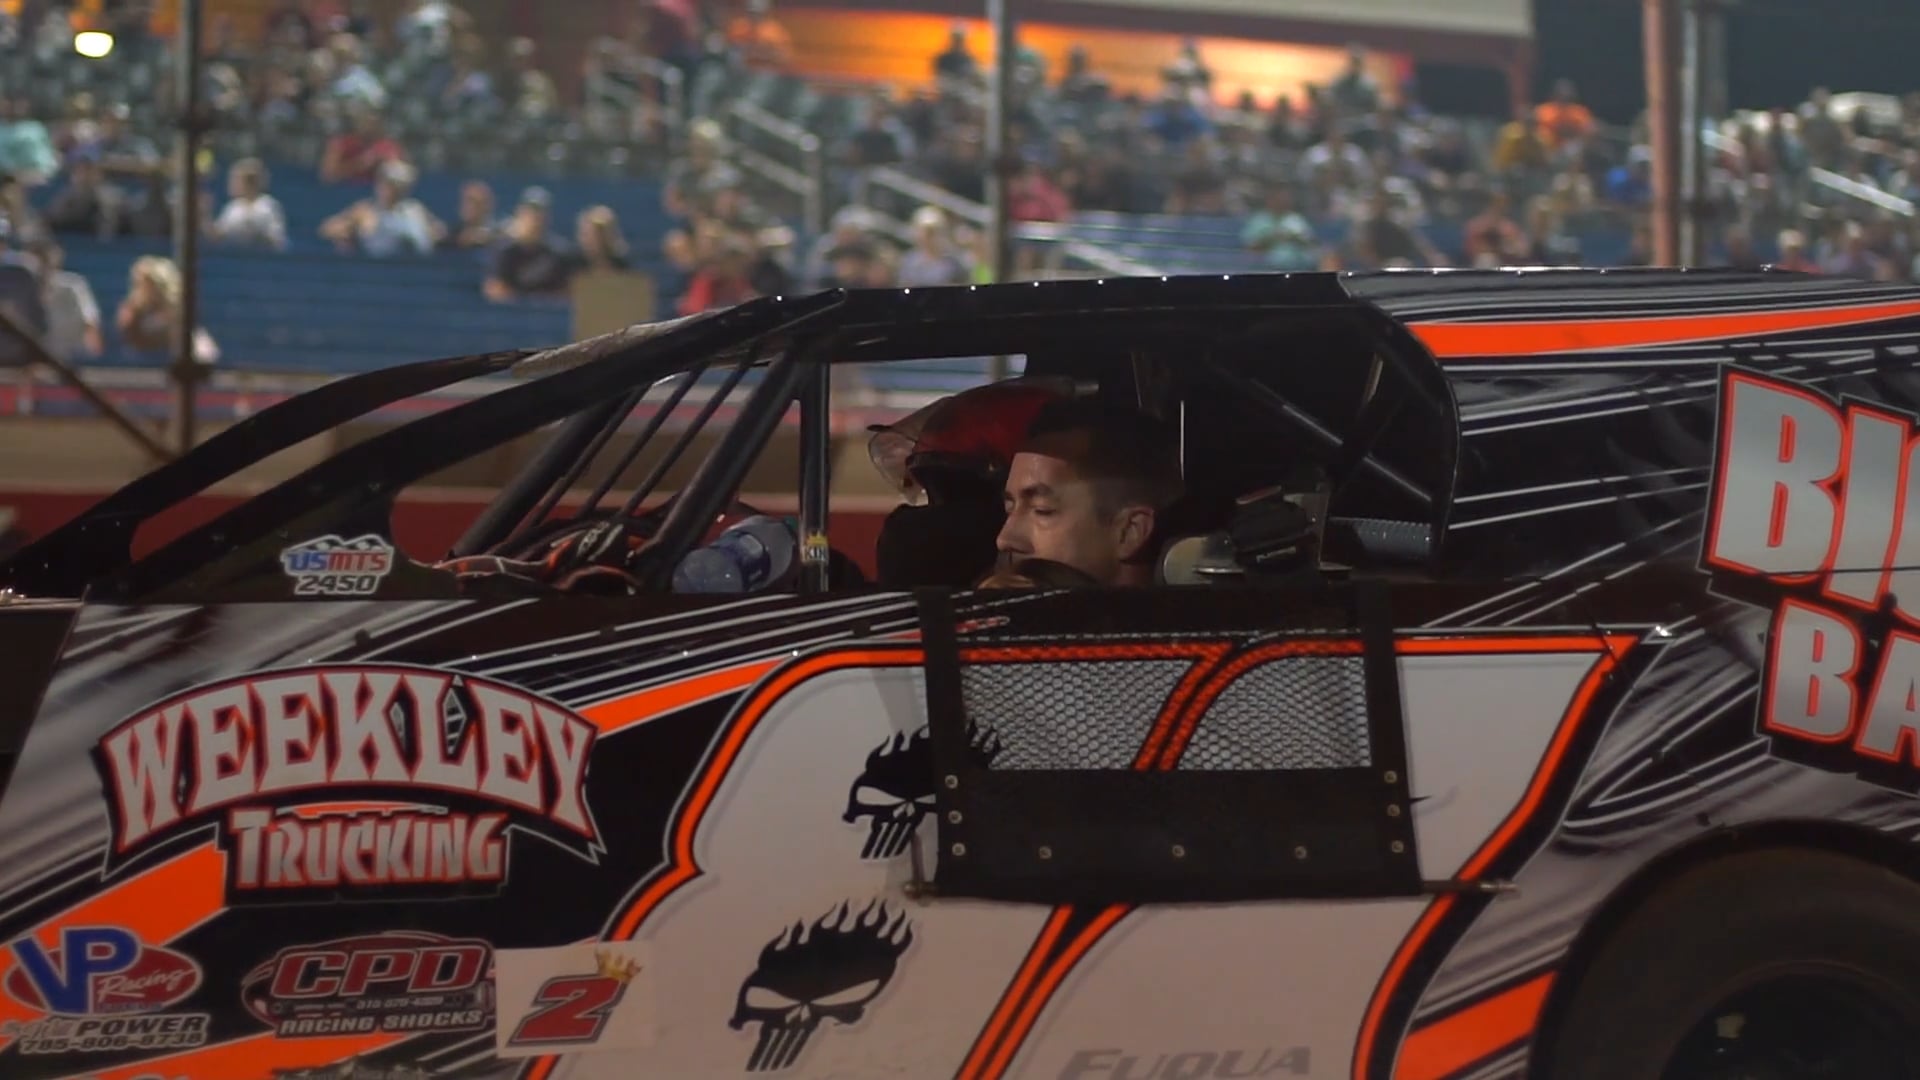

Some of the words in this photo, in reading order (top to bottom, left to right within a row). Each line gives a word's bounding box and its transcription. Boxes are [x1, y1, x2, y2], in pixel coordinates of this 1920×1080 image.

[1707, 371, 1920, 626] BI
[286, 551, 388, 572] USMTS
[298, 574, 376, 592] 2450
[103, 668, 598, 853] WEEKLEY
[10, 925, 143, 1015] VP
[96, 968, 195, 1003] Racing
[270, 945, 487, 999] CPD
[74, 1015, 208, 1038] POWER
[279, 1014, 375, 1036] RACING
[382, 1010, 484, 1031] SHOCKS
[506, 973, 629, 1047] 2
